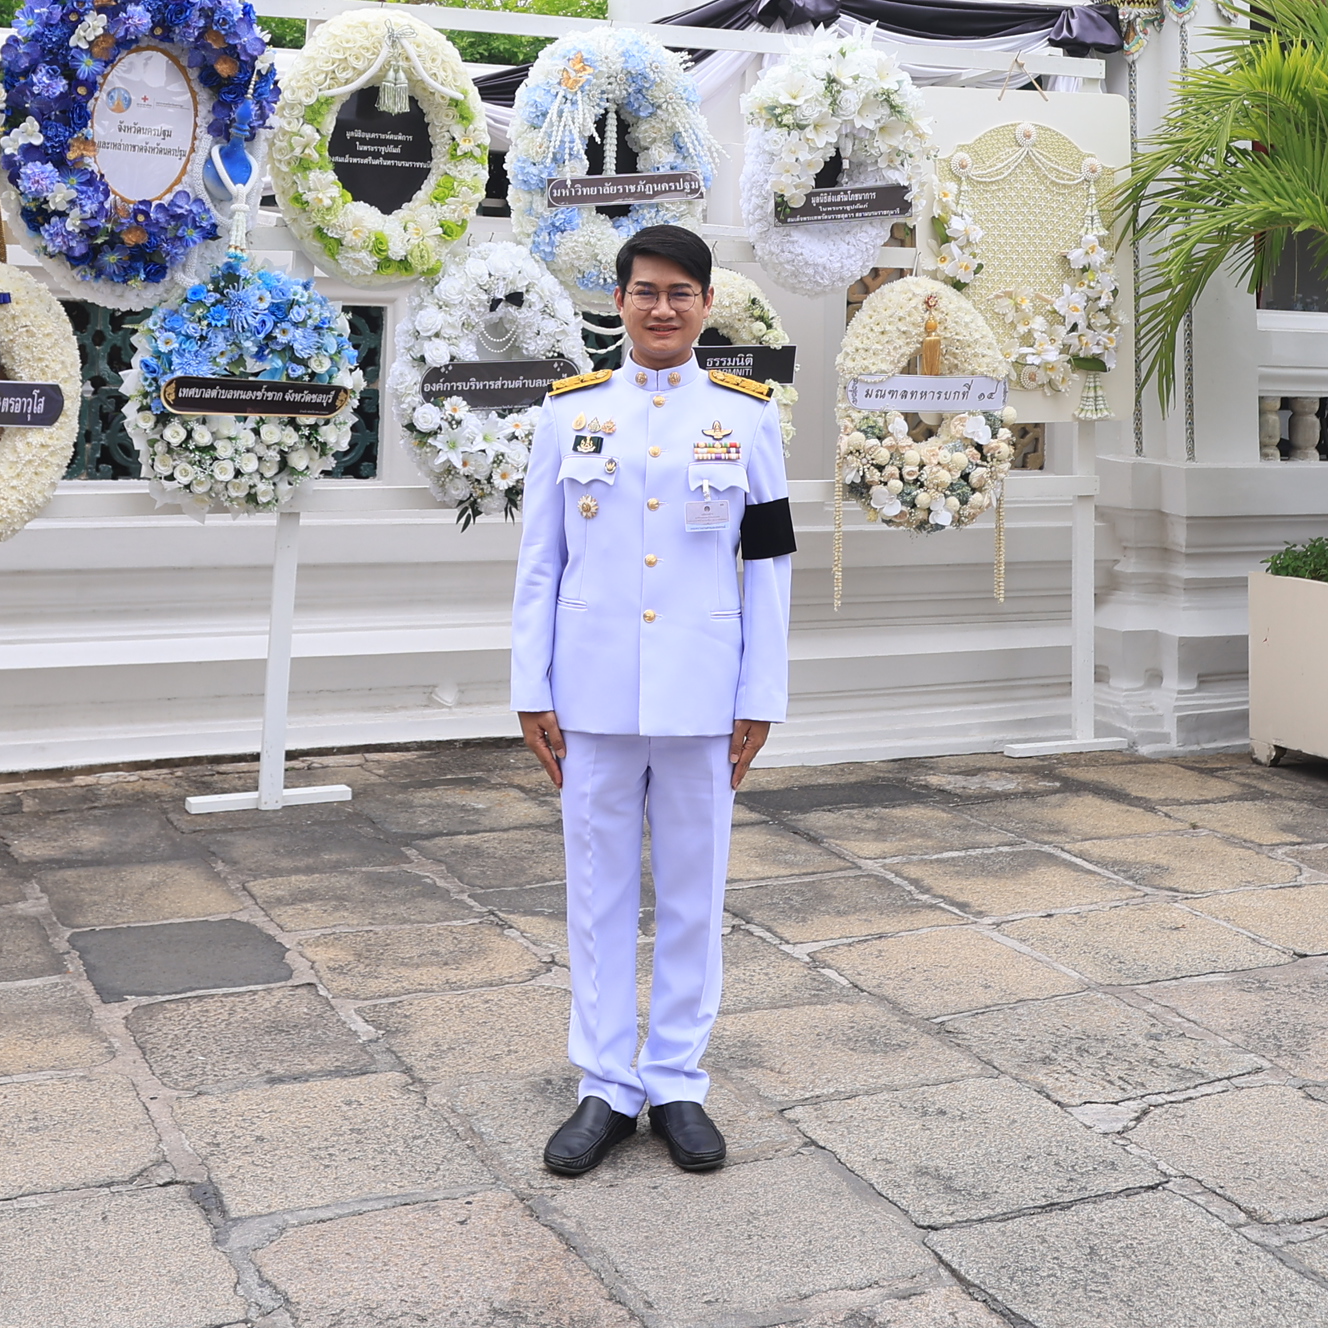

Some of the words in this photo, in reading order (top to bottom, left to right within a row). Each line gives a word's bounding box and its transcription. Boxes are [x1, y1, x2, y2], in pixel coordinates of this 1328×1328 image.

[117, 120, 173, 140] จังหวัดนครปฐม
[552, 178, 699, 197] มหาวิทยาลัยราชภัฏนครปฐม
[706, 354, 753, 367] ธรรมนิติ
[284, 388, 336, 408] จังหวัดชลบุรี
[864, 380, 974, 401] มณฑลทหารบกที่
